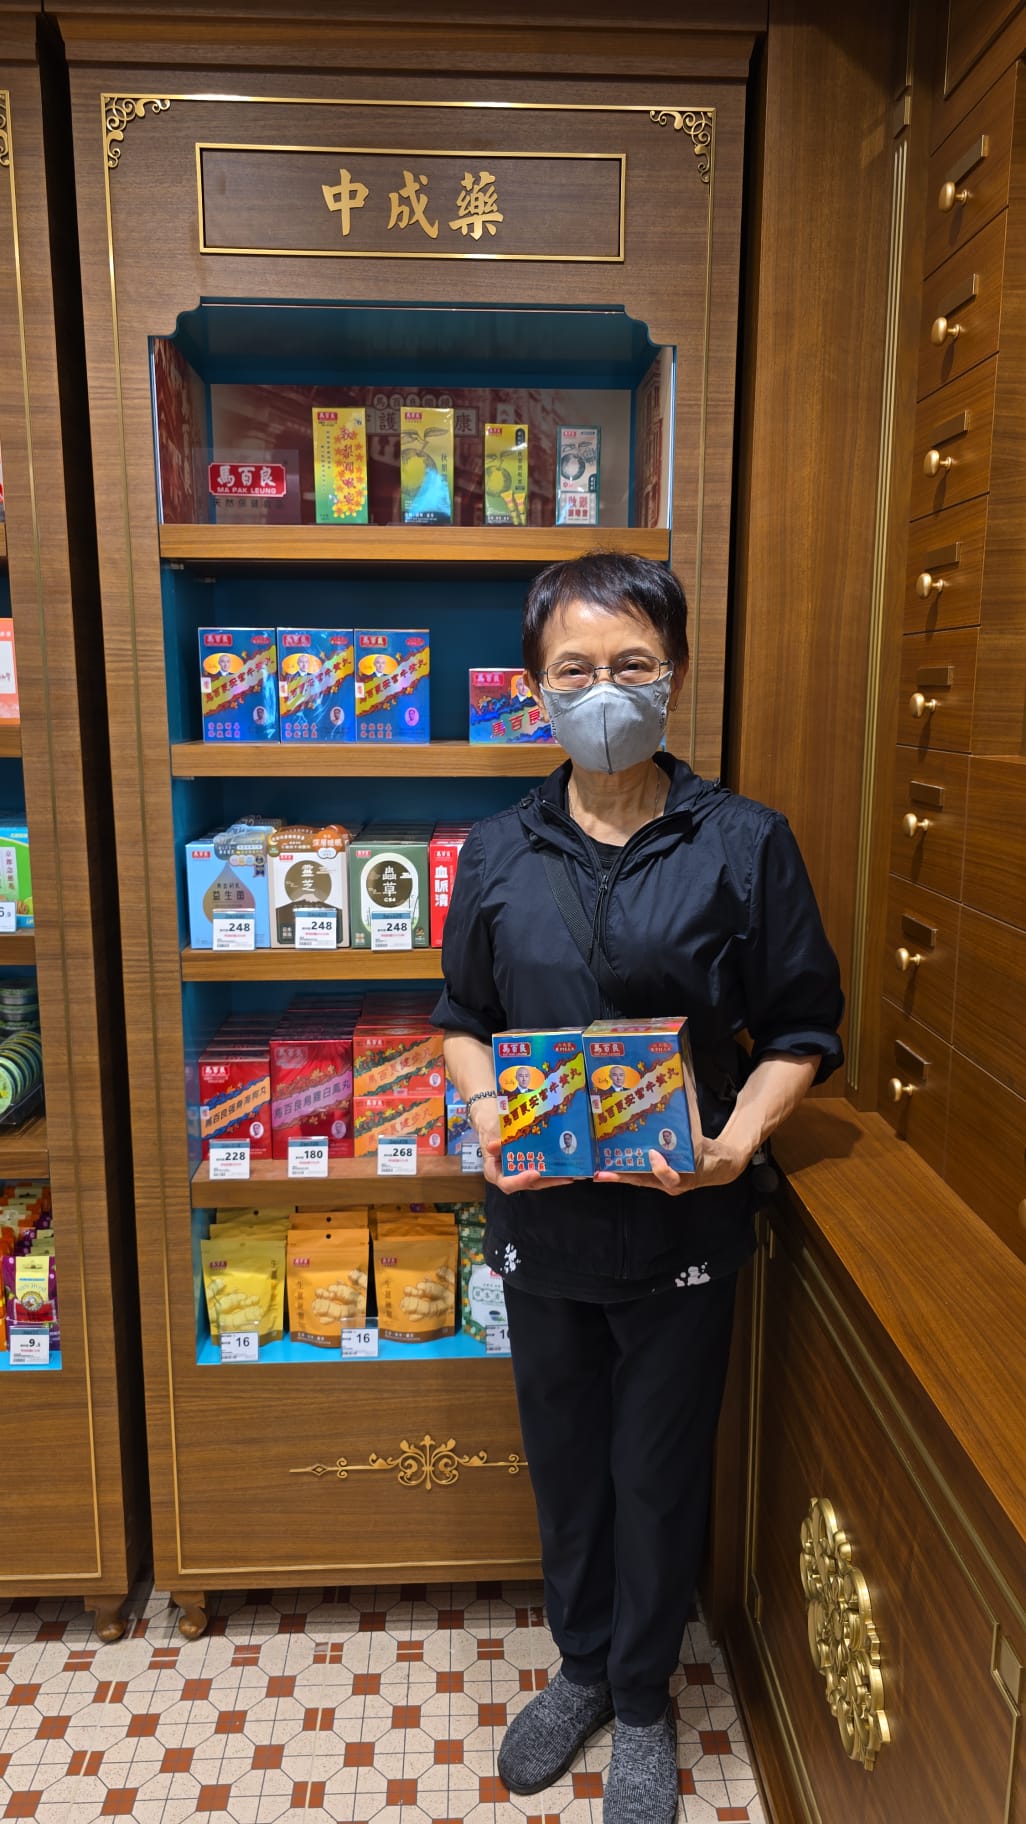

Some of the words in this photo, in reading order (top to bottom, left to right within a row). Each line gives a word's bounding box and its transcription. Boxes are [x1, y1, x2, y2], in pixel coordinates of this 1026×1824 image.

[321, 168, 504, 240] 中成藥
[217, 465, 276, 487] 馬百良
[229, 923, 250, 932] 248
[311, 921, 332, 930] 248
[386, 922, 408, 932] 248
[225, 1152, 246, 1161] 228
[304, 1150, 323, 1159] 180
[392, 1148, 413, 1157] 268
[236, 1337, 250, 1347] 16
[356, 1333, 371, 1343] 16
